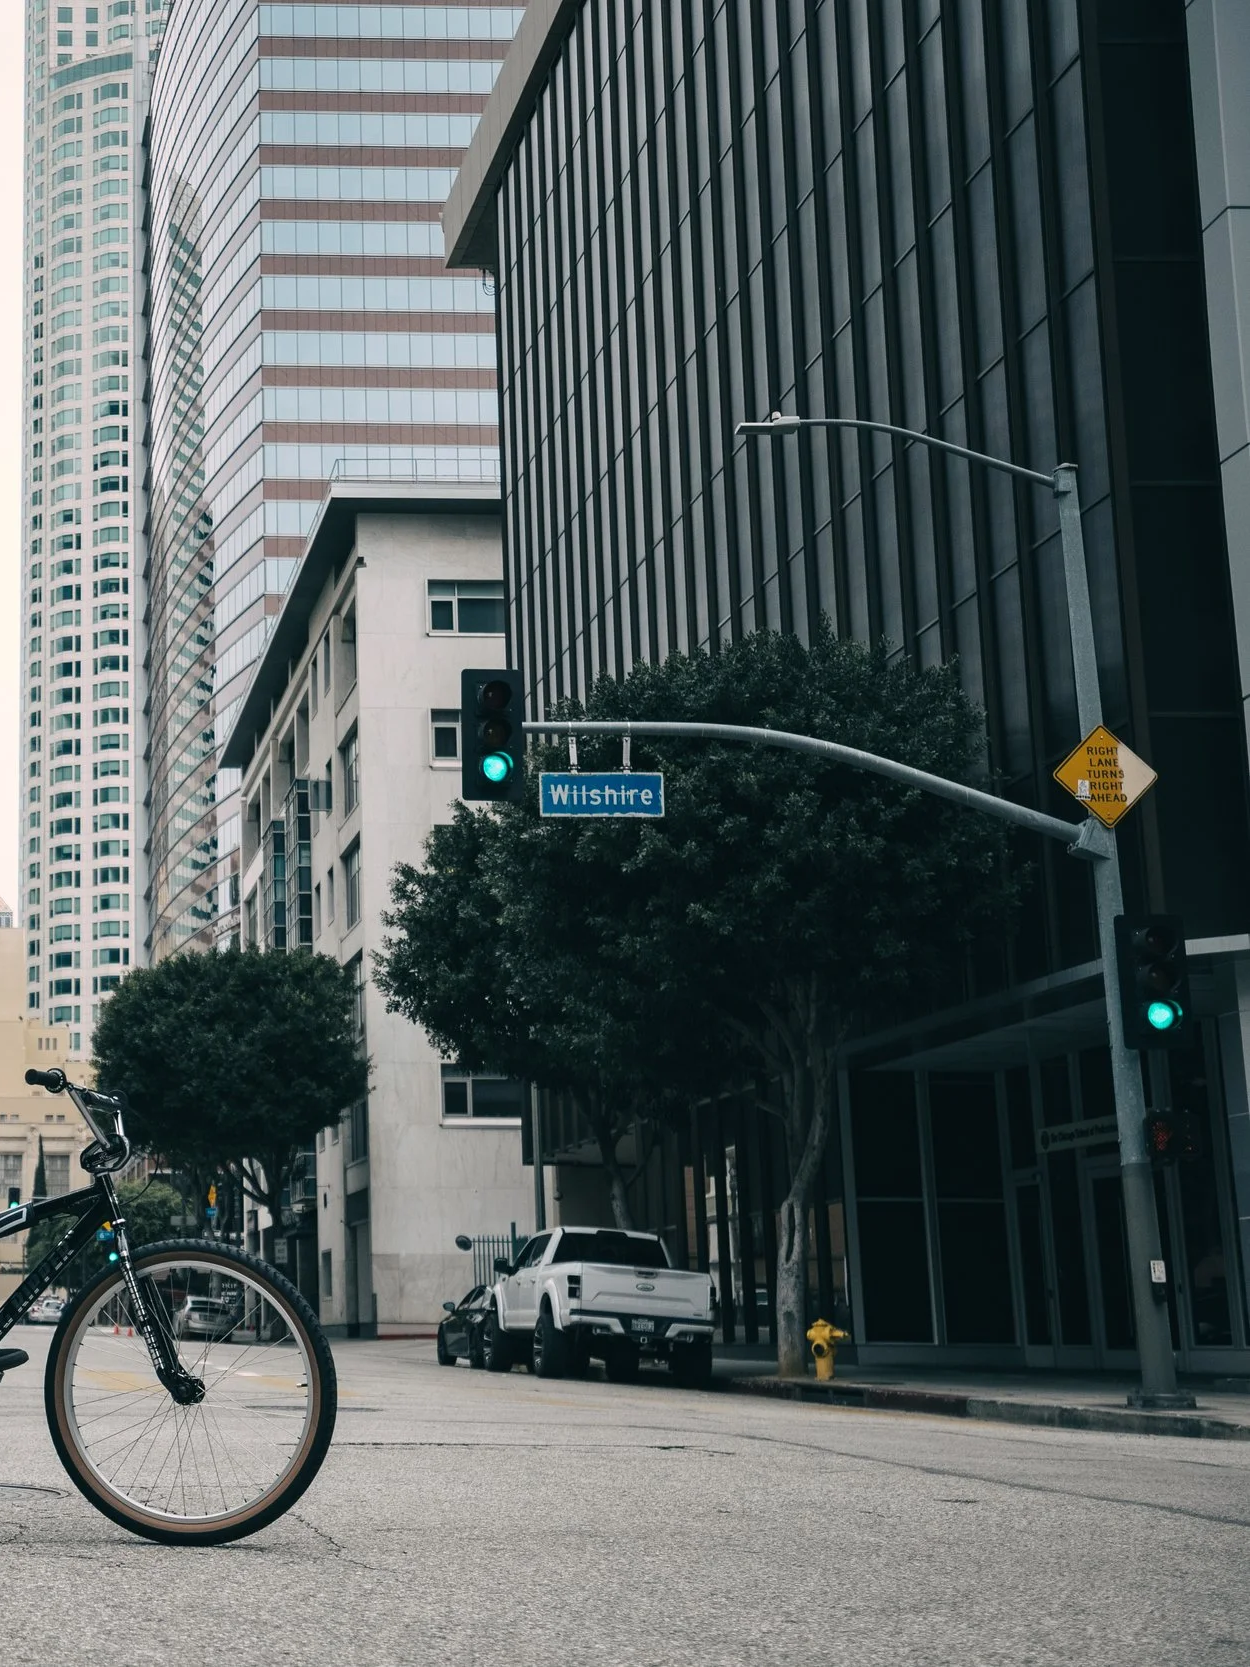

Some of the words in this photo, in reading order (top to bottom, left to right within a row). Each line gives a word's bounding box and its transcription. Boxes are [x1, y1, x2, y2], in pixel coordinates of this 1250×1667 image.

[1086, 746, 1118, 755] RIGHT
[1090, 758, 1119, 767] LANE
[1086, 769, 1125, 779] TURNS
[1090, 781, 1124, 791] RIGHT
[550, 784, 653, 806] Wilshire
[1090, 793, 1128, 803] AHEAD
